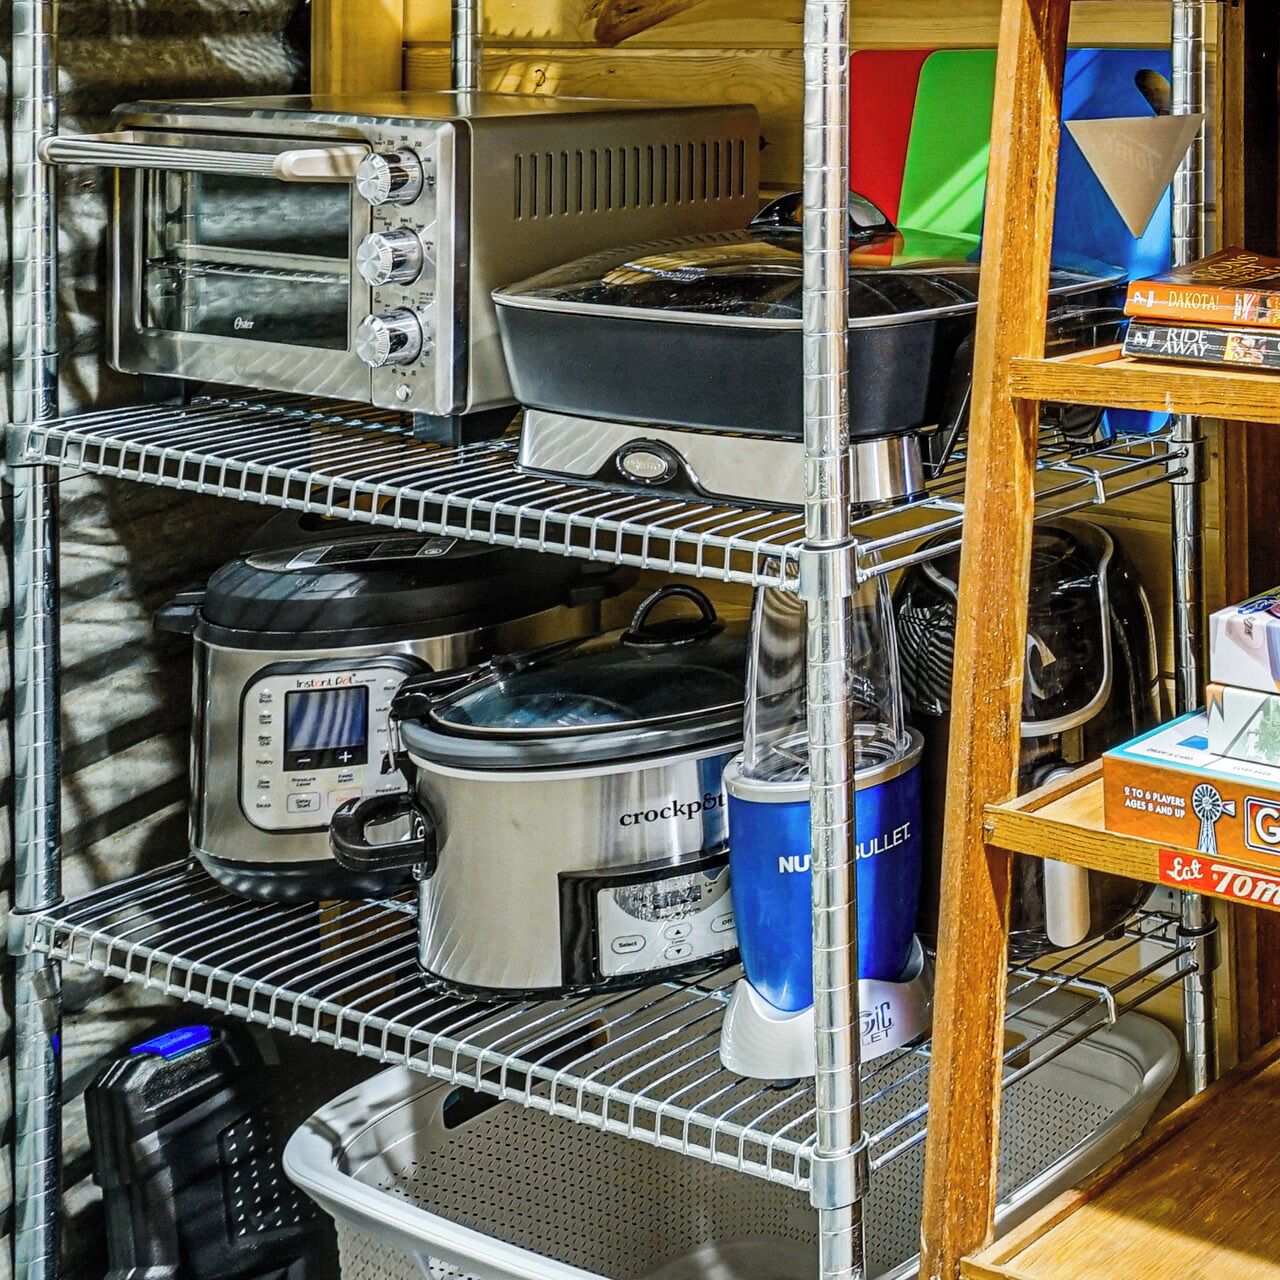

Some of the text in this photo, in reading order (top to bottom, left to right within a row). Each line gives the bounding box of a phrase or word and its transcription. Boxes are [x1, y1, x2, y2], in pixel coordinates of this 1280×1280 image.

[1167, 291, 1221, 311] DAKOTA!
[233, 316, 255, 331] Oster
[1167, 328, 1209, 345] RIDE
[1160, 342, 1211, 357] AWAY
[296, 678, 332, 689] Instant
[335, 675, 353, 686] Pot
[1123, 786, 1186, 808] 2 TO 6 PLAYERS
[619, 792, 726, 827] crockpot
[1125, 798, 1186, 819] AGES 8 AND UP
[1165, 858, 1204, 882] Eat
[722, 918, 733, 926] Off
